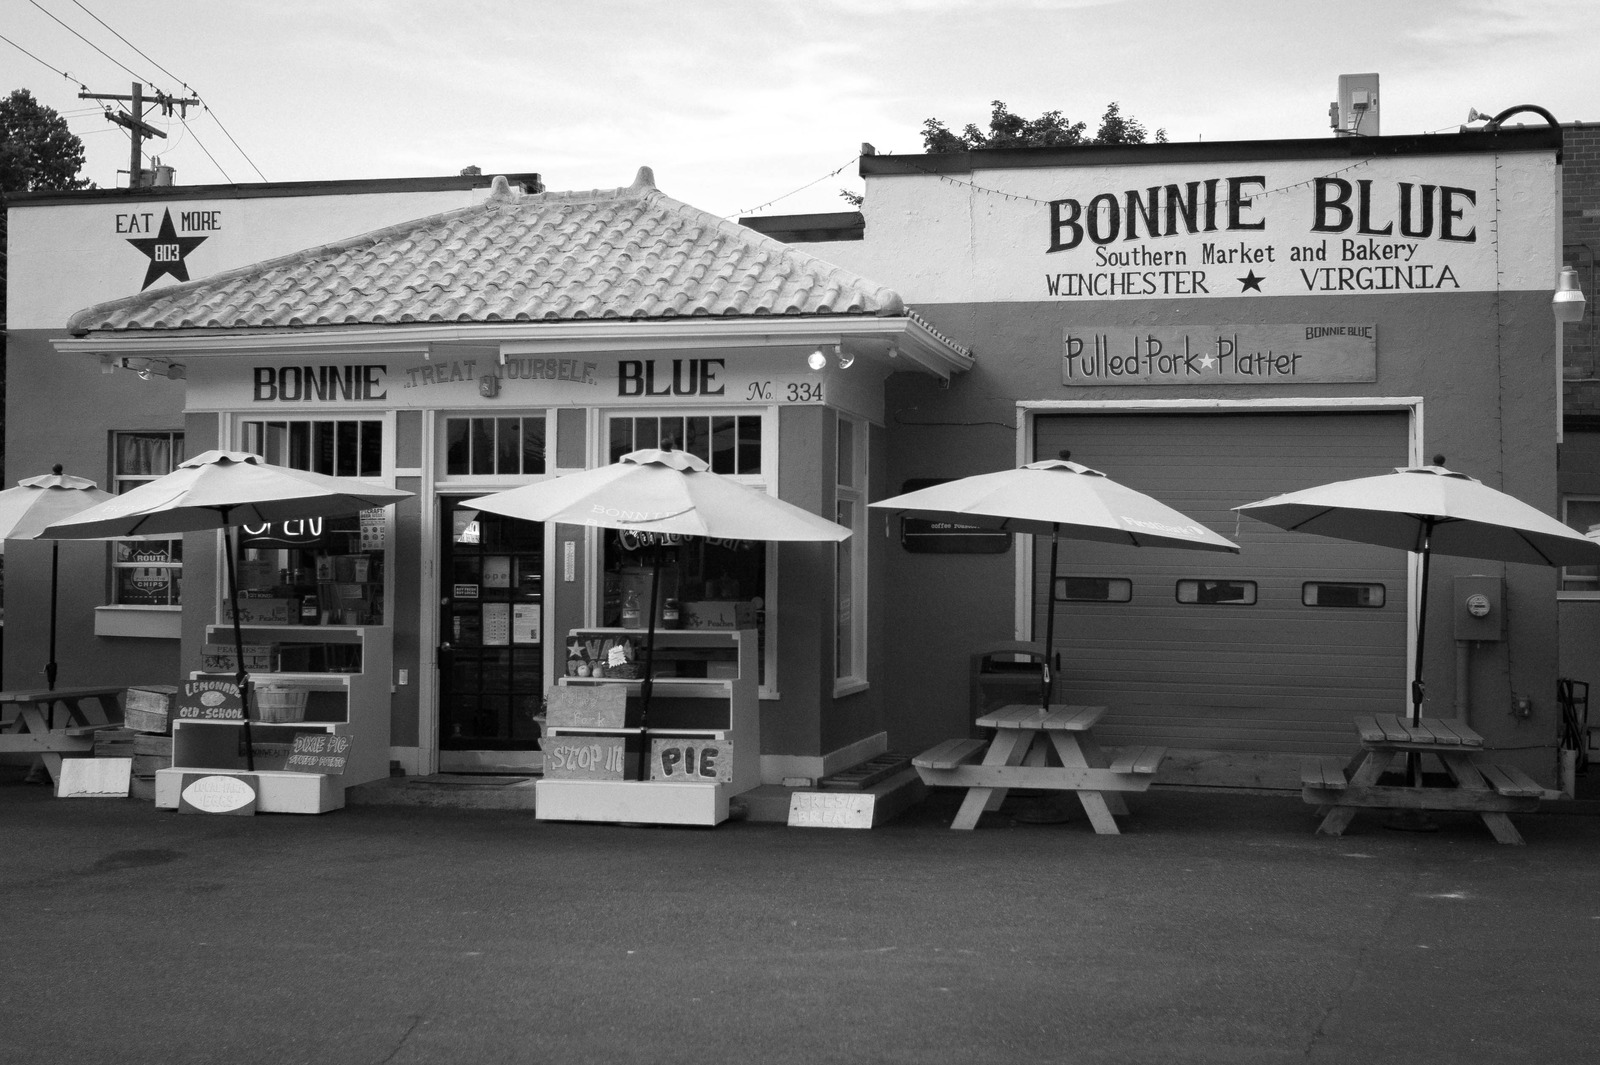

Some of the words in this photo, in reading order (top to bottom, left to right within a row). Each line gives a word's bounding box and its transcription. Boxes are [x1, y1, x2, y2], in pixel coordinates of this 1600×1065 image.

[115, 212, 154, 234] EAT
[180, 210, 222, 232] MORE
[1045, 175, 1267, 254] BONNIE
[1311, 176, 1477, 243] BLUE
[154, 243, 180, 262] 803
[1095, 246, 1187, 268] Southern
[1202, 243, 1276, 265] Market
[1290, 239, 1326, 262] and
[1342, 237, 1419, 264] Bakery
[1045, 271, 1210, 296] WINCHESTER
[1299, 264, 1461, 292] VIRGINIA
[1305, 326, 1347, 341] BONNIE
[1347, 326, 1373, 340] BLUE
[1215, 335, 1303, 378] Platter
[252, 364, 388, 402] BONNIE
[617, 358, 726, 398] BLUE
[786, 382, 824, 402] 334
[136, 554, 166, 562] ROUTE
[294, 735, 326, 753] DIXIE
[327, 735, 349, 753] PIG
[551, 744, 602, 772] STOP
[661, 746, 719, 778] PIE
